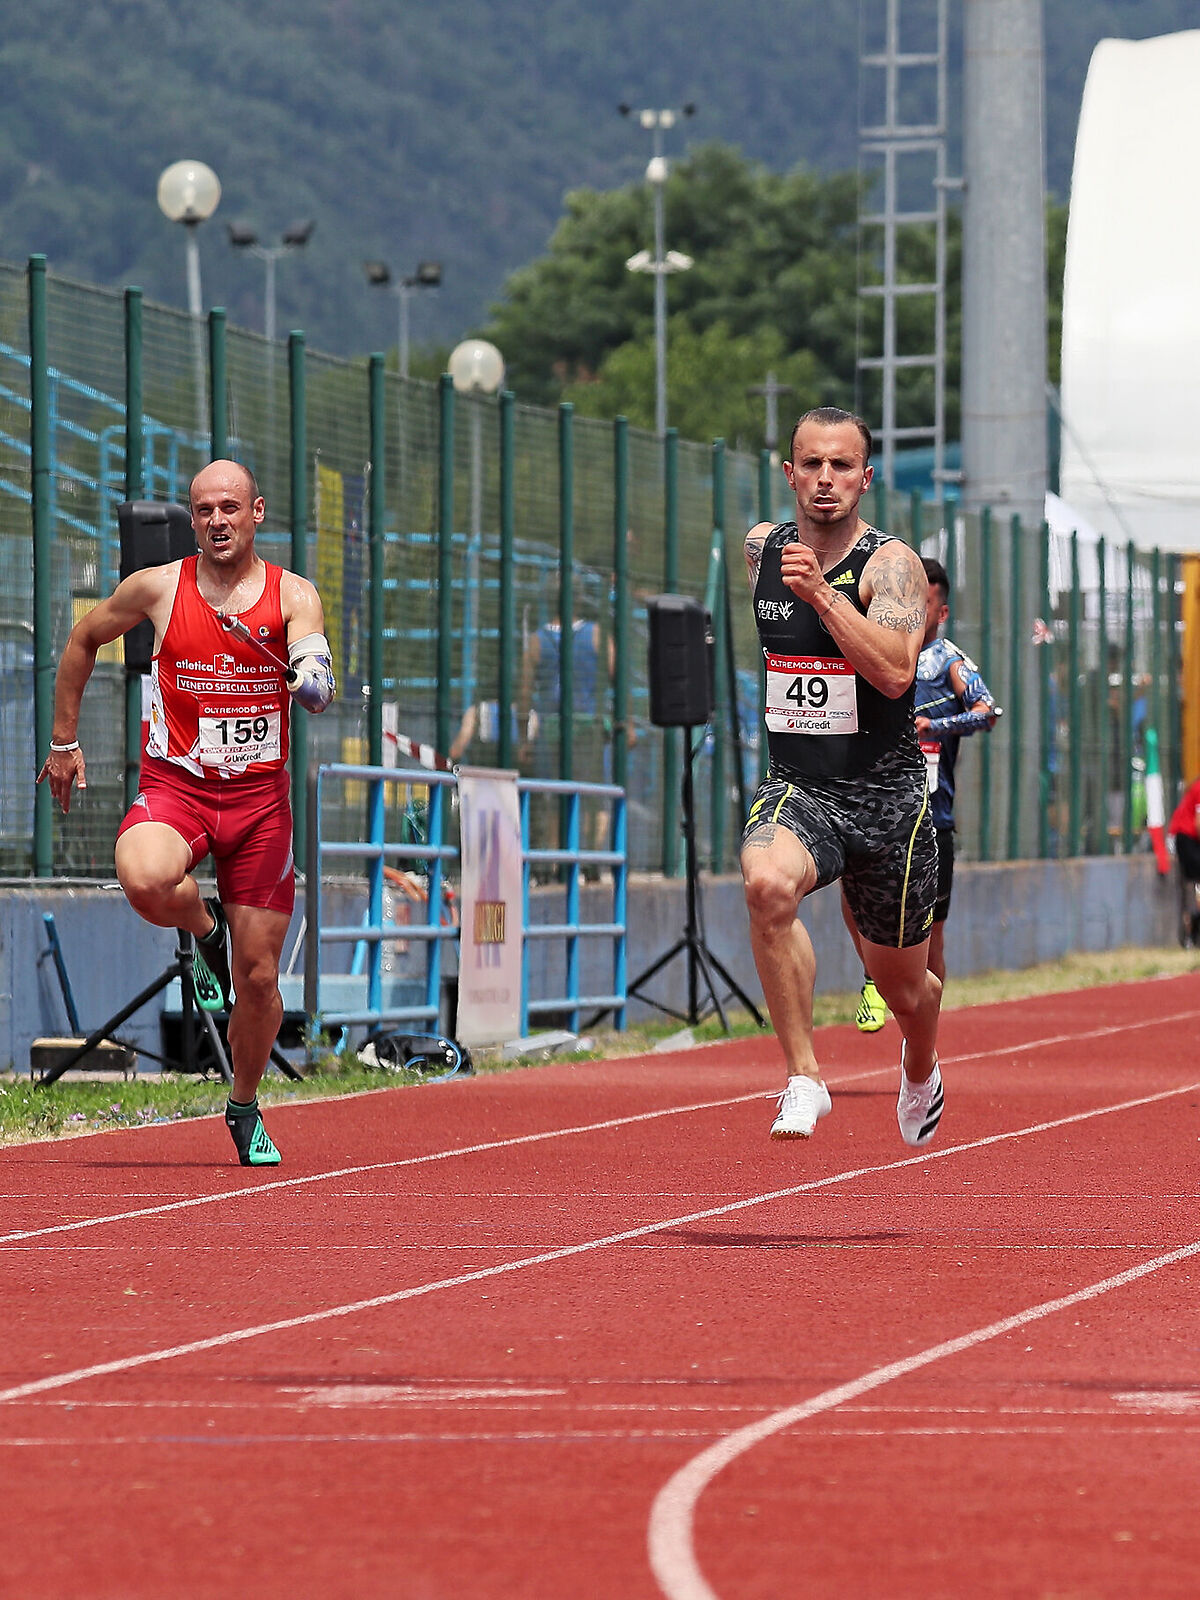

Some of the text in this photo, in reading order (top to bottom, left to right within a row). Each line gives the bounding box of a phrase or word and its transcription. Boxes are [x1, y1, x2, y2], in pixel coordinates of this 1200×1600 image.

[176, 659, 213, 672] atletica
[236, 664, 256, 673] due
[180, 680, 278, 692] VENETO SPECIAL SPORT
[786, 677, 829, 708] 49
[215, 716, 269, 745] 159
[795, 719, 831, 729] UniCredit
[232, 752, 262, 763] UniCredit
